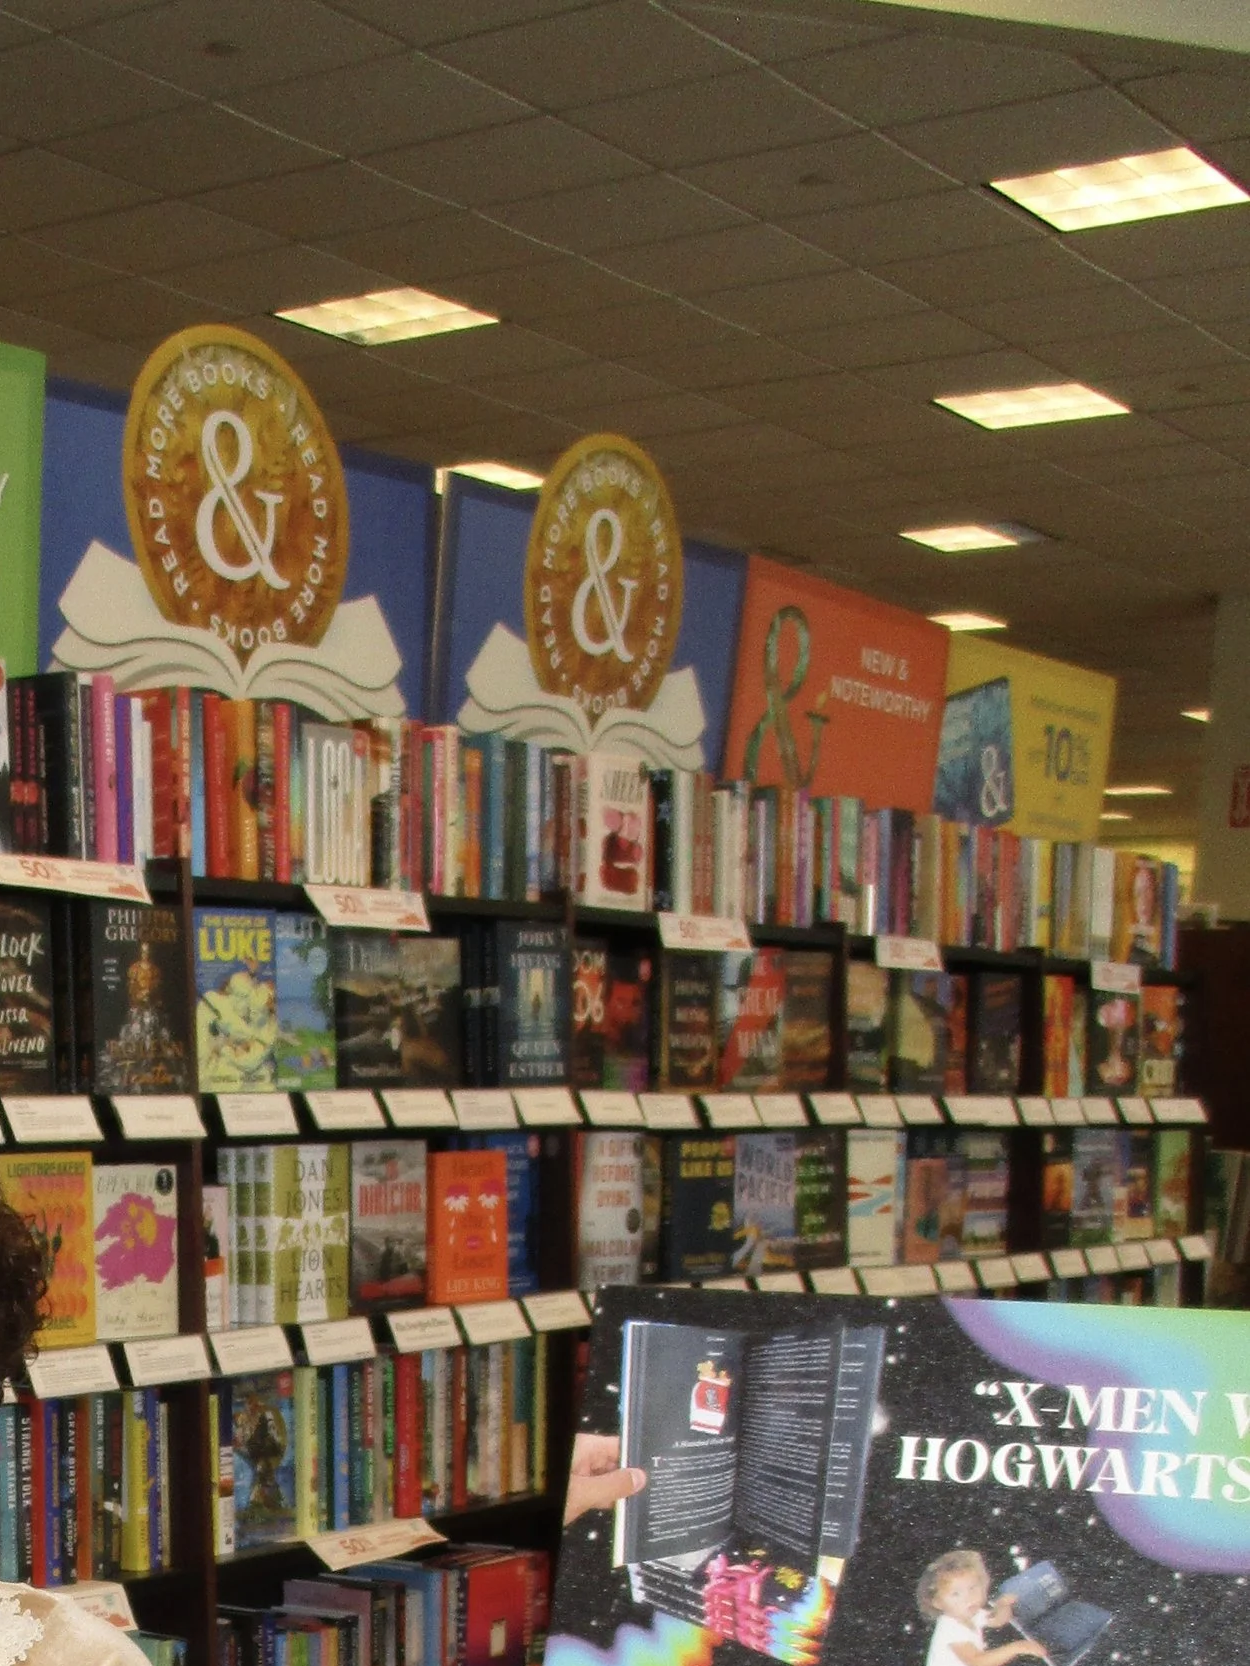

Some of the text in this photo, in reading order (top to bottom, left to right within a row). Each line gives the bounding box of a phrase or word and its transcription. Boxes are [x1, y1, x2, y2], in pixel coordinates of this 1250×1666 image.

[185, 363, 270, 401] BOOKS
[145, 386, 186, 481] MORE
[291, 423, 328, 520] READ
[149, 498, 191, 597] READ
[290, 535, 329, 625] MORE
[199, 927, 273, 963] LUKE
[294, 1160, 334, 1182] DAN
[895, 1436, 1250, 1504] HOGWARTS
